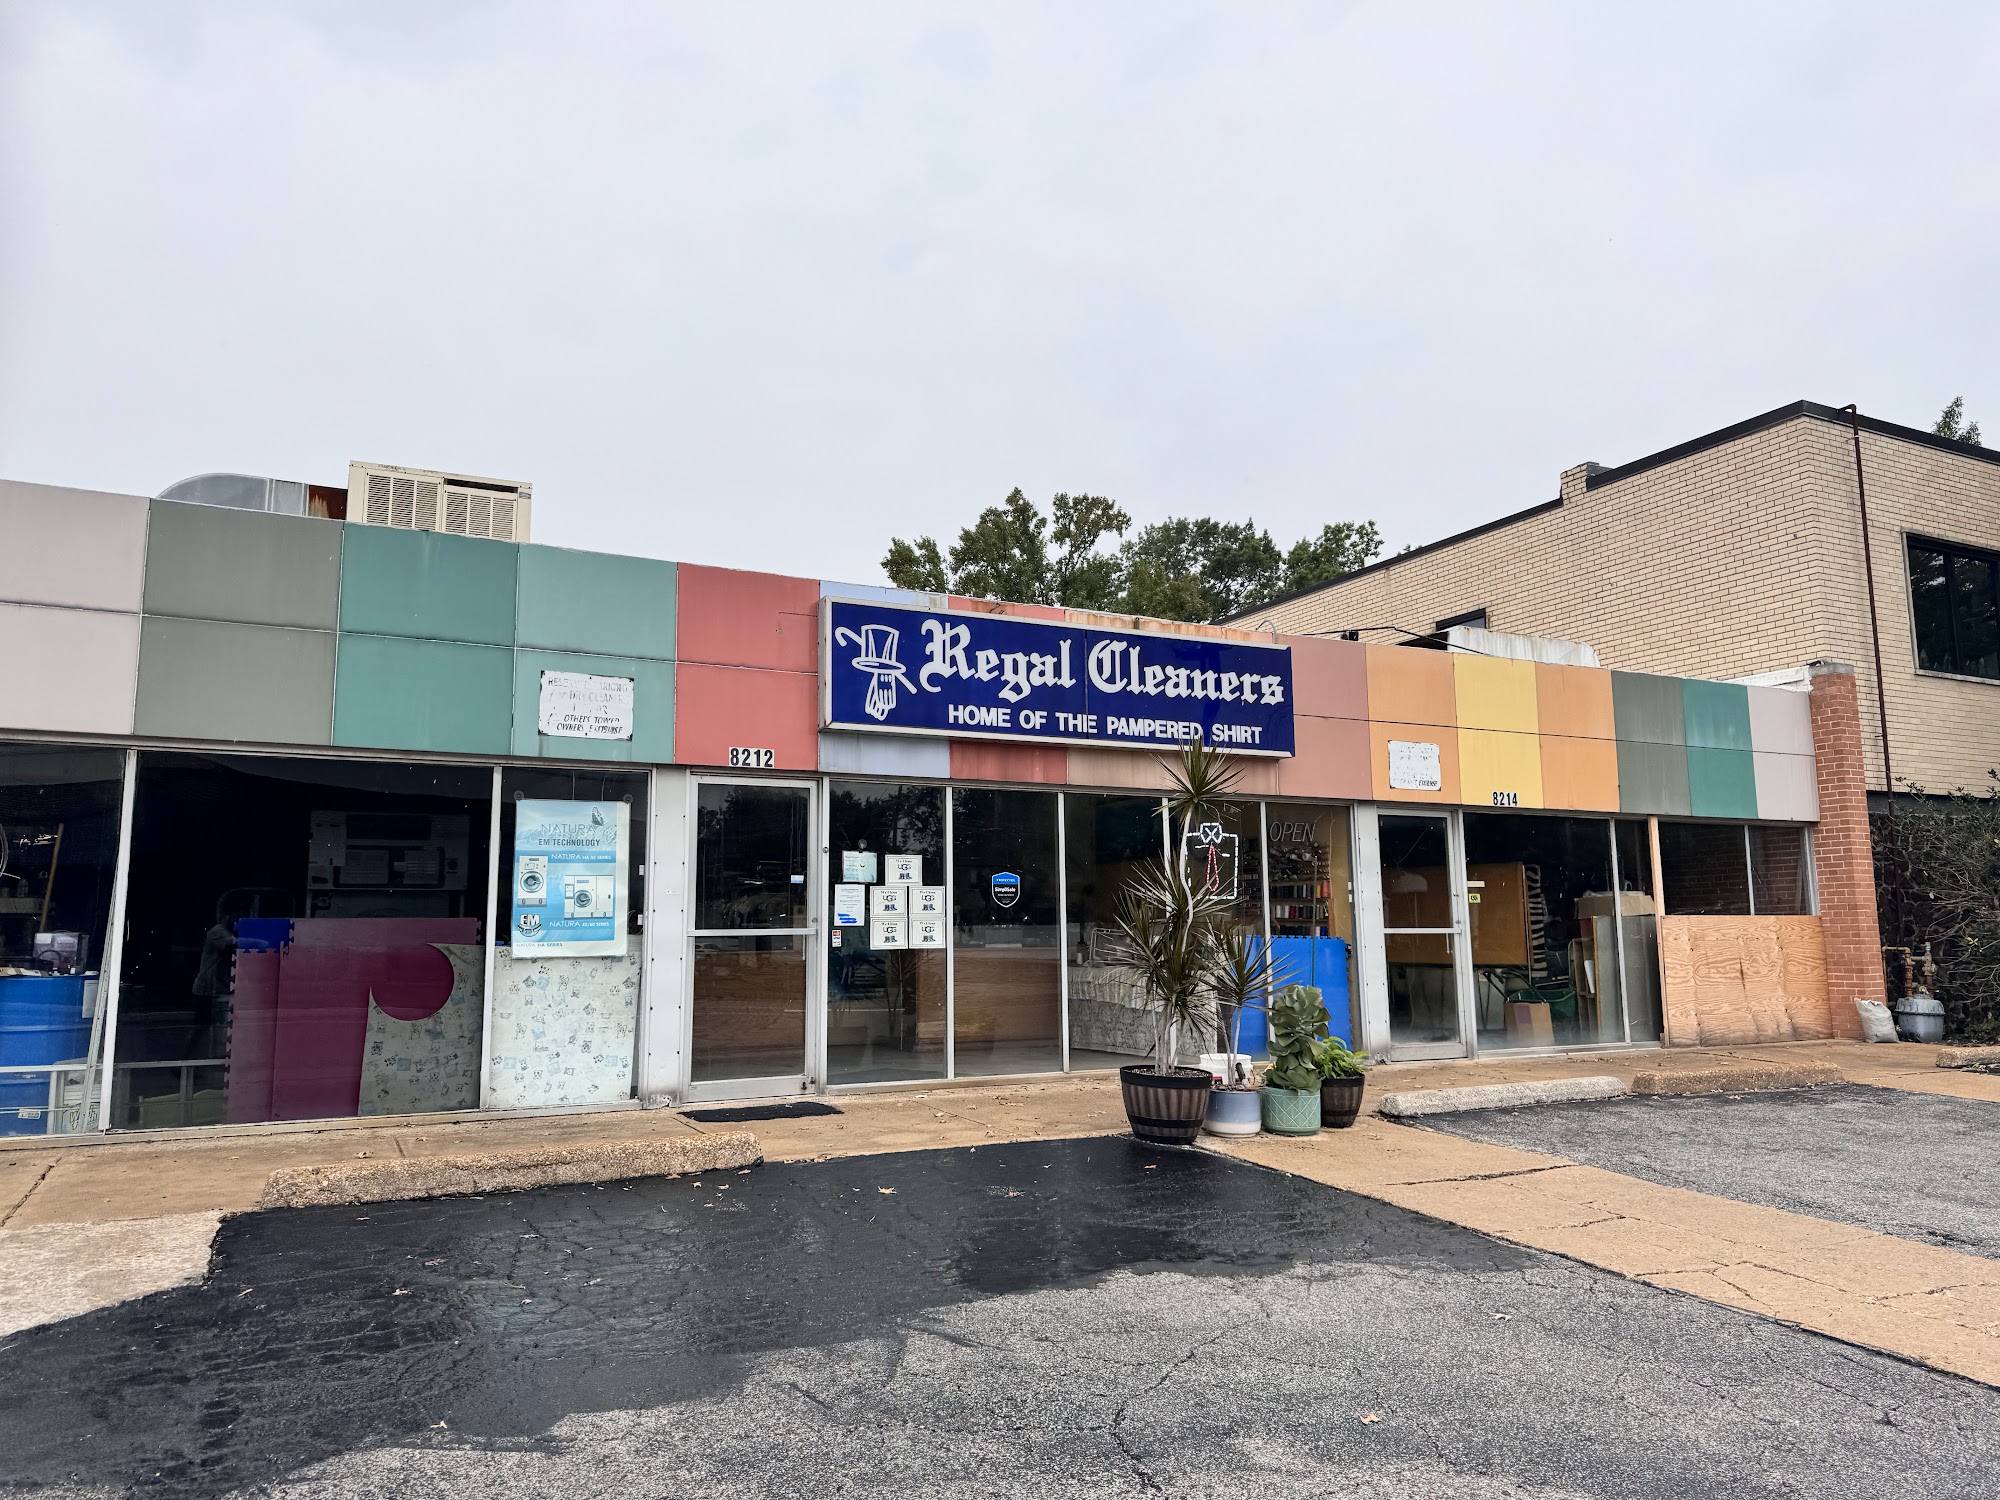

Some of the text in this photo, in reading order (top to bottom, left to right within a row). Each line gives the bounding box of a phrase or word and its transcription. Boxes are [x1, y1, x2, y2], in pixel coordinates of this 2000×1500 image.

[919, 619, 1285, 706] Regal Cleaners
[948, 704, 1263, 744] HOME OF THE PAMPERED SHIRT
[730, 748, 773, 768] 8212
[1492, 792, 1518, 806] 8214
[541, 824, 596, 834] NATURA
[1270, 822, 1316, 842] OPEN
[520, 914, 540, 926] EM
